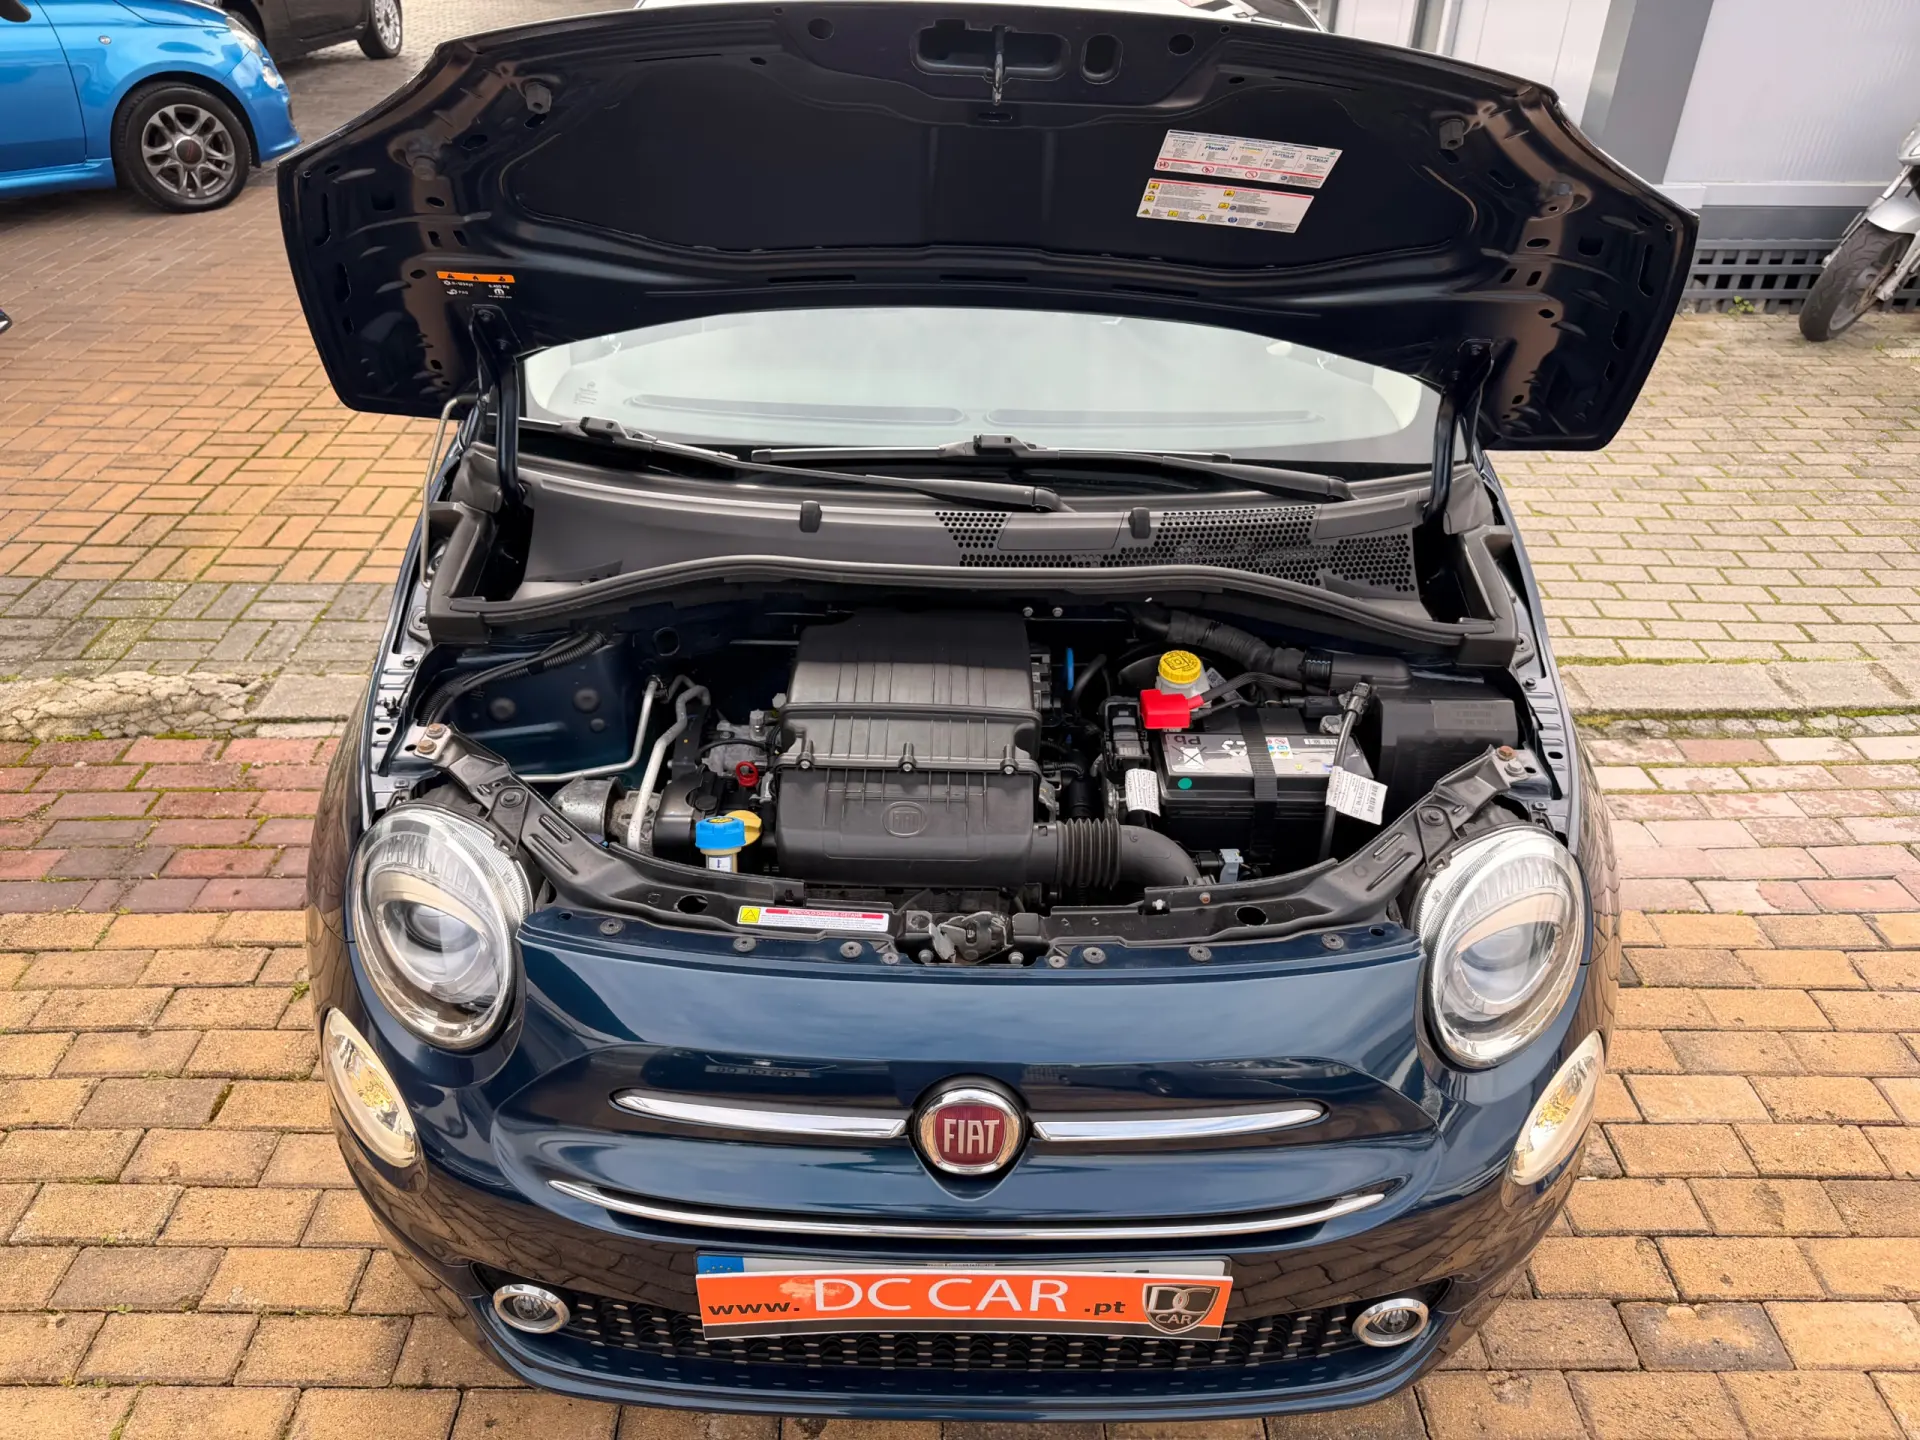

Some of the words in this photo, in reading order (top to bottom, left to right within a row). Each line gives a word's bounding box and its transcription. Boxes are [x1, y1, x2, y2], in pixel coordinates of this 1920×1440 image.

[943, 1118, 1000, 1154] FIAT
[708, 1302, 800, 1315] www.
[814, 1278, 912, 1311] DC
[928, 1278, 1069, 1312] CAR
[1084, 1301, 1126, 1316] .pt
[1148, 1286, 1212, 1315] DC
[1155, 1313, 1193, 1325] CAR
